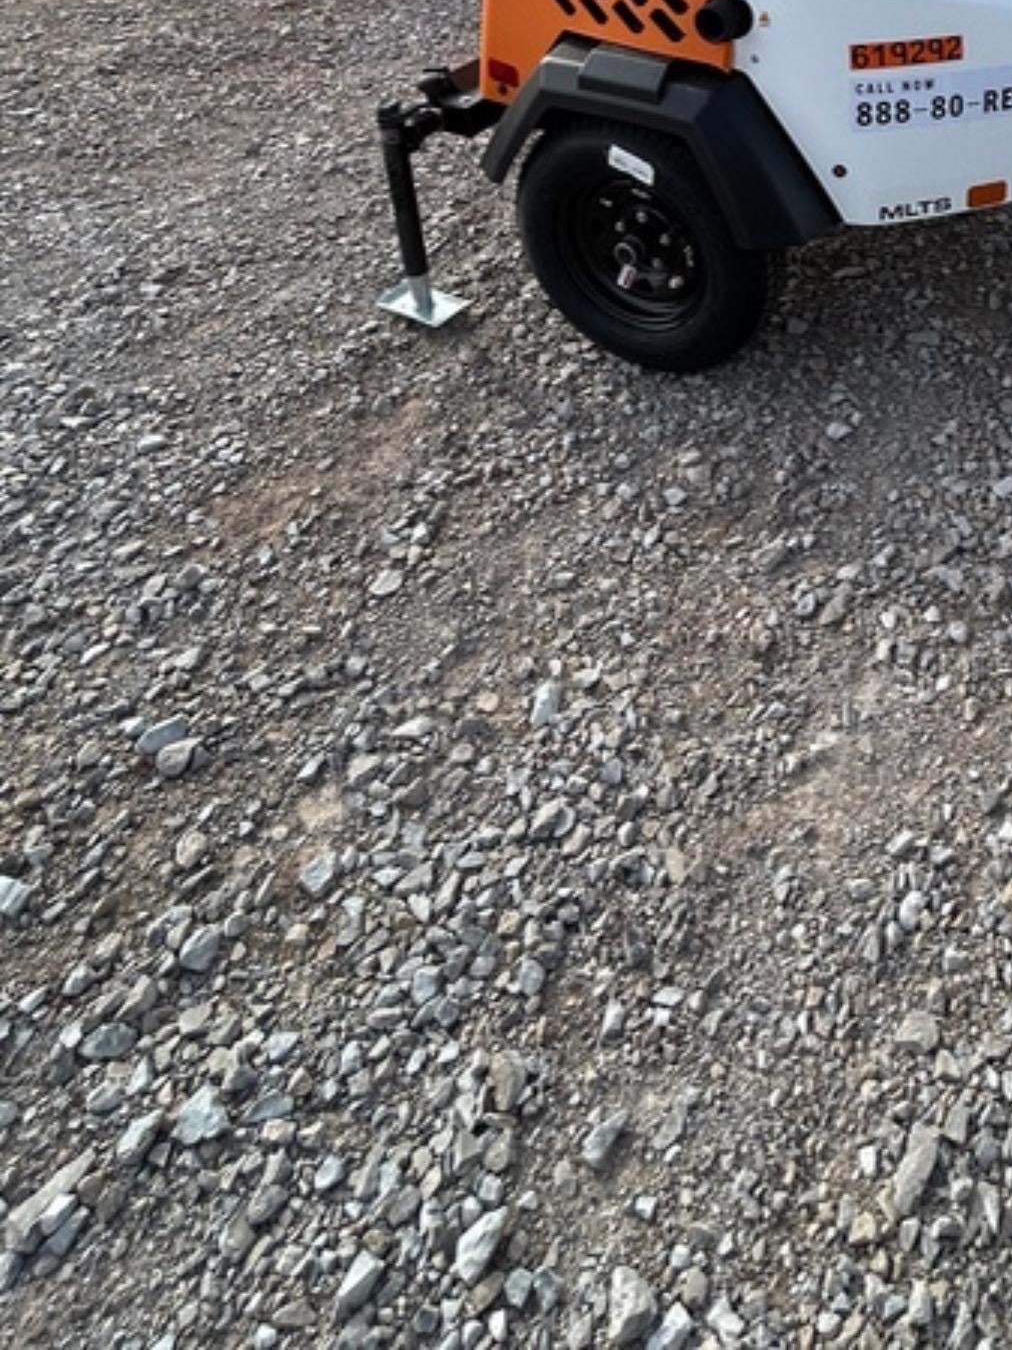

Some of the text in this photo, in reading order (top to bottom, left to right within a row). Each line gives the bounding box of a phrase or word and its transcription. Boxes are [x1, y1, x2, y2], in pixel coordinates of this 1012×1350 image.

[851, 35, 963, 69] 619292
[855, 78, 936, 96] CALL NOW
